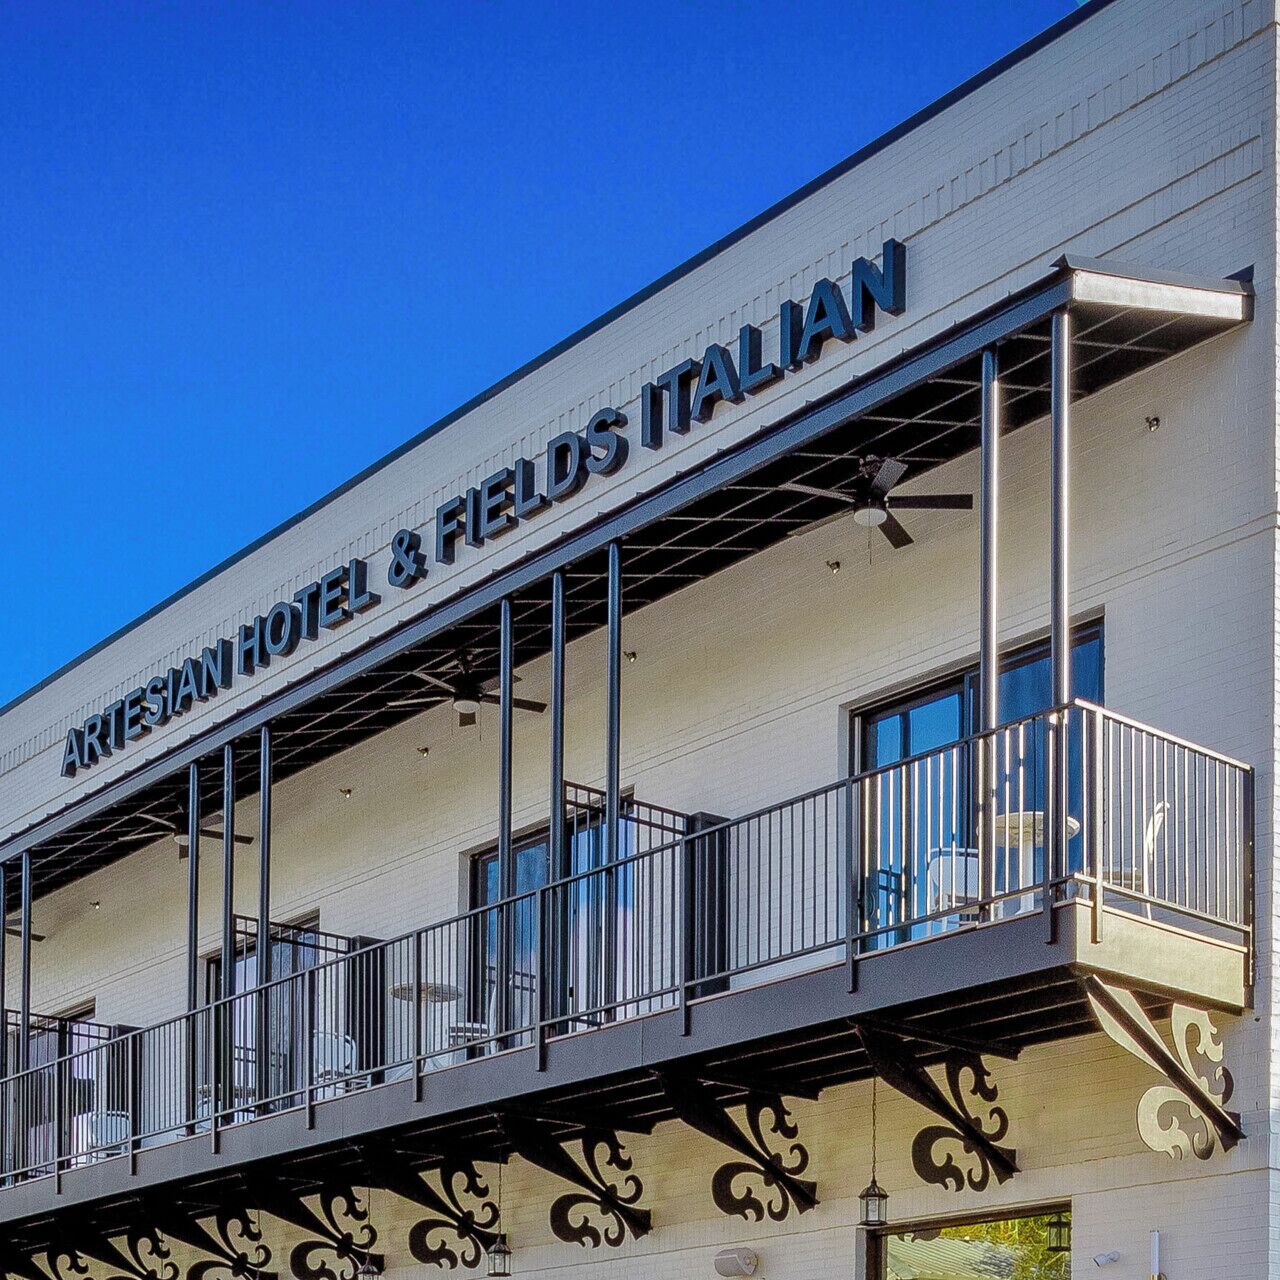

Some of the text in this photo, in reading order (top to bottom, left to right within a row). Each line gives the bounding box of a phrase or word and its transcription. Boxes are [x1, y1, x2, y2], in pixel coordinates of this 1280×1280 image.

[60, 238, 907, 779] ARTESIAN HOTEL & FIELDS ITALIAN
